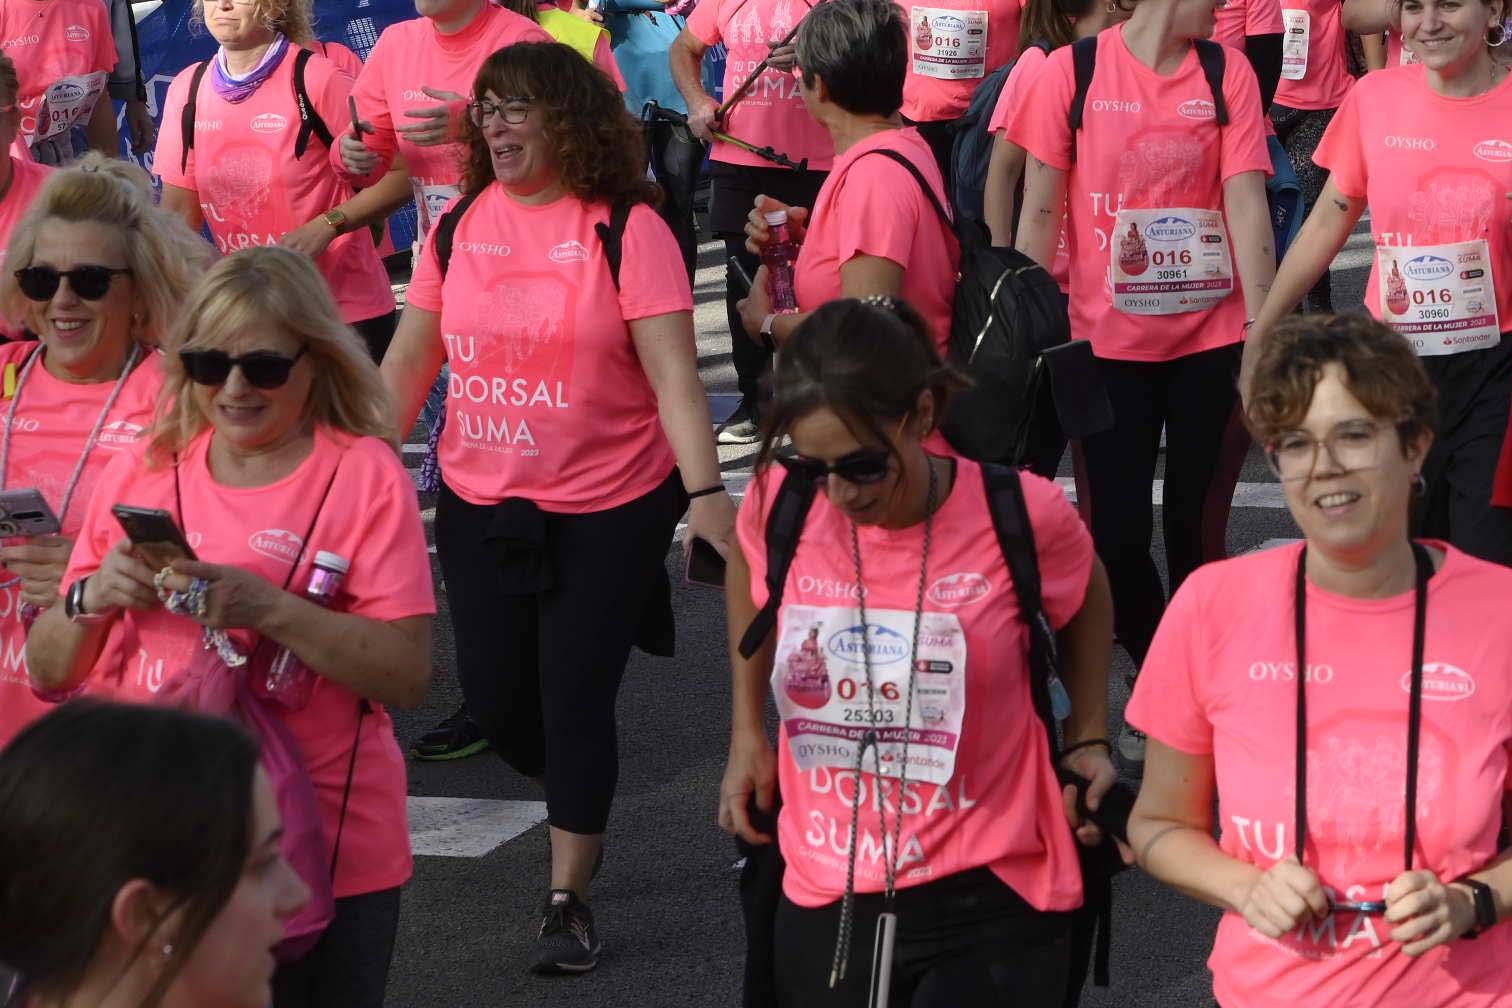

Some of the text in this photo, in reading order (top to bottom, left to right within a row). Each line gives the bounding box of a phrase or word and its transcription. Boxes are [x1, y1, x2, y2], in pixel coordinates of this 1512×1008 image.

[935, 37, 960, 47] 016
[1092, 99, 1141, 113] OYSHO
[1384, 136, 1434, 151] OYSHO
[1089, 192, 1124, 217] TU
[1149, 227, 1194, 236] ASTURIANA
[459, 241, 511, 257] OYSHO
[1152, 250, 1192, 266] 016
[1157, 270, 1187, 279] 30961
[1407, 265, 1450, 275] ASTURIANA
[1126, 284, 1159, 292] CARRERA
[1124, 298, 1160, 307] OYSHO
[1412, 288, 1452, 305] 016
[1419, 308, 1449, 320] 30960
[1423, 323, 1432, 331] DE
[1433, 322, 1443, 330] LA
[1443, 321, 1468, 329] MUJER
[1453, 334, 1490, 345] Santander
[445, 334, 475, 363] TU
[451, 374, 569, 408] DORSAL
[456, 410, 535, 446] SUMA
[798, 575, 868, 599] OYSHO
[837, 678, 900, 700] 06
[843, 708, 894, 723] 25303
[797, 721, 848, 739] CARRERA
[848, 728, 864, 740] DE
[798, 744, 850, 759] OYSHO
[805, 811, 925, 870] SUMA
[1231, 815, 1285, 860] TU
